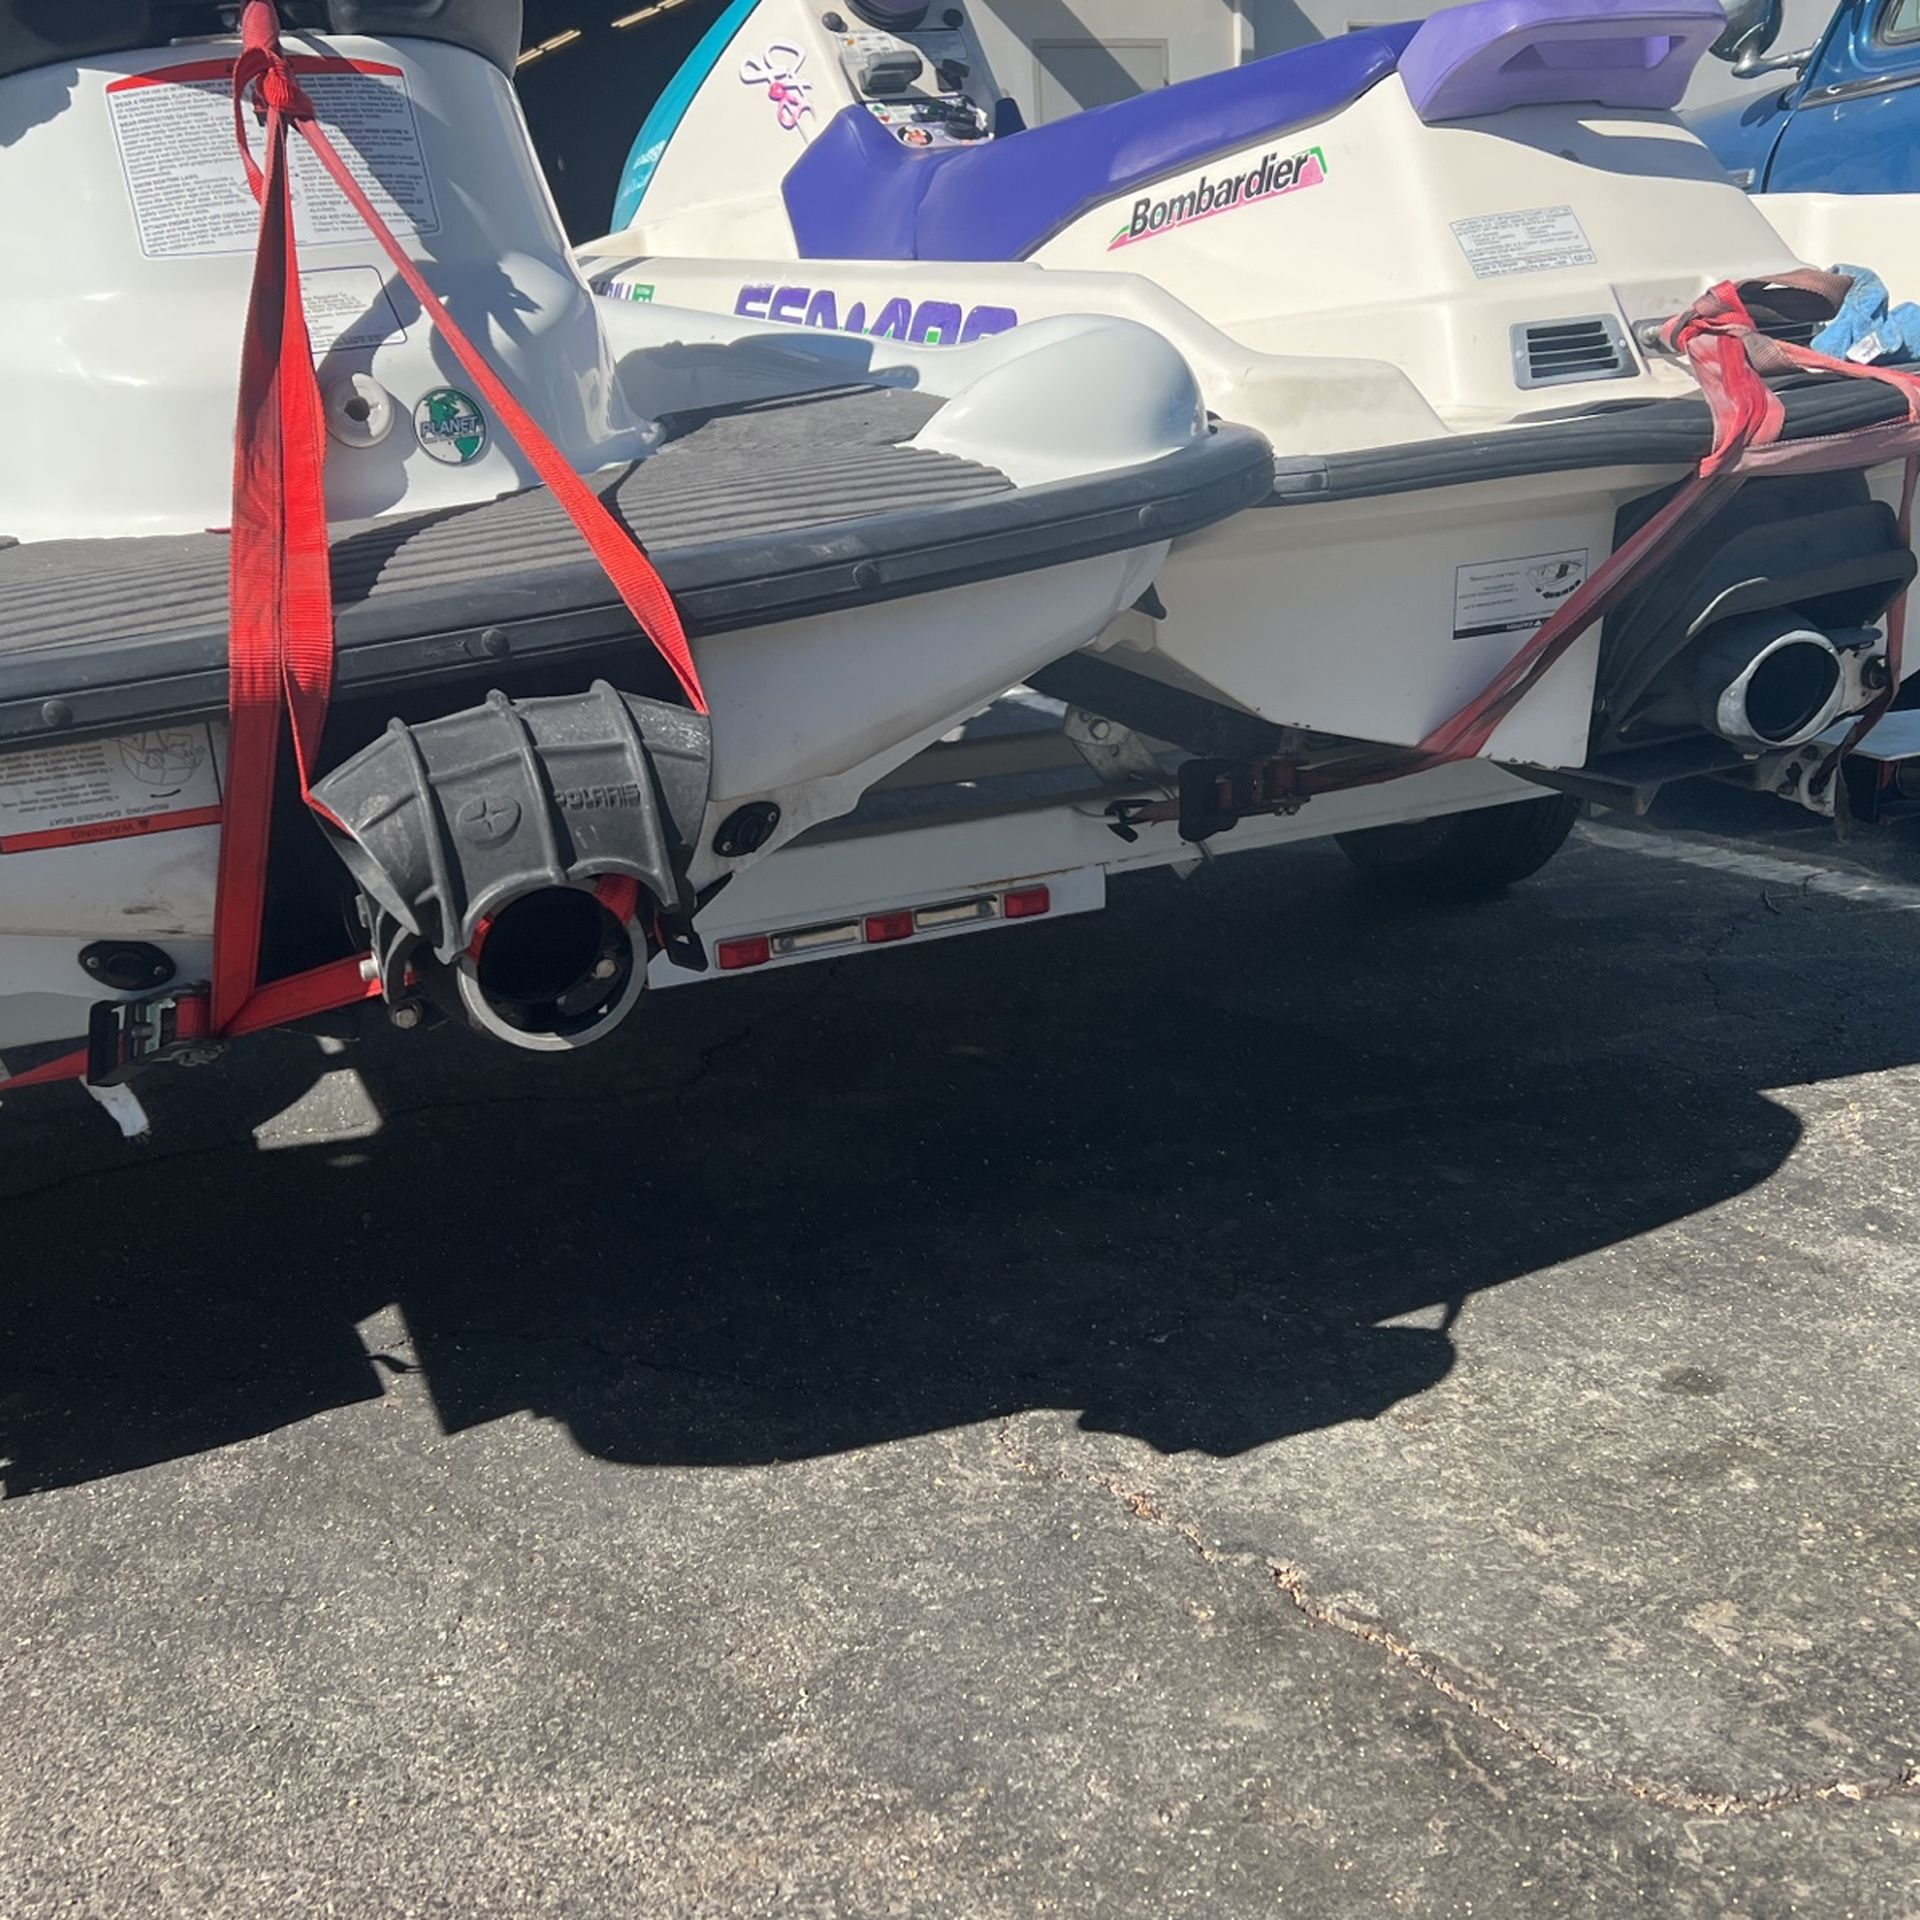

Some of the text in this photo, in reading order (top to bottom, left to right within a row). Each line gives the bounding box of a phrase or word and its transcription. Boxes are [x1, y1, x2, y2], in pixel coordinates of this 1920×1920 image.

[1129, 152, 1309, 238] Bombardier
[419, 413, 479, 438] PLANET
[553, 782, 641, 810] POLARIS
[49, 816, 75, 827] BOAT
[70, 822, 135, 840] WARNING
